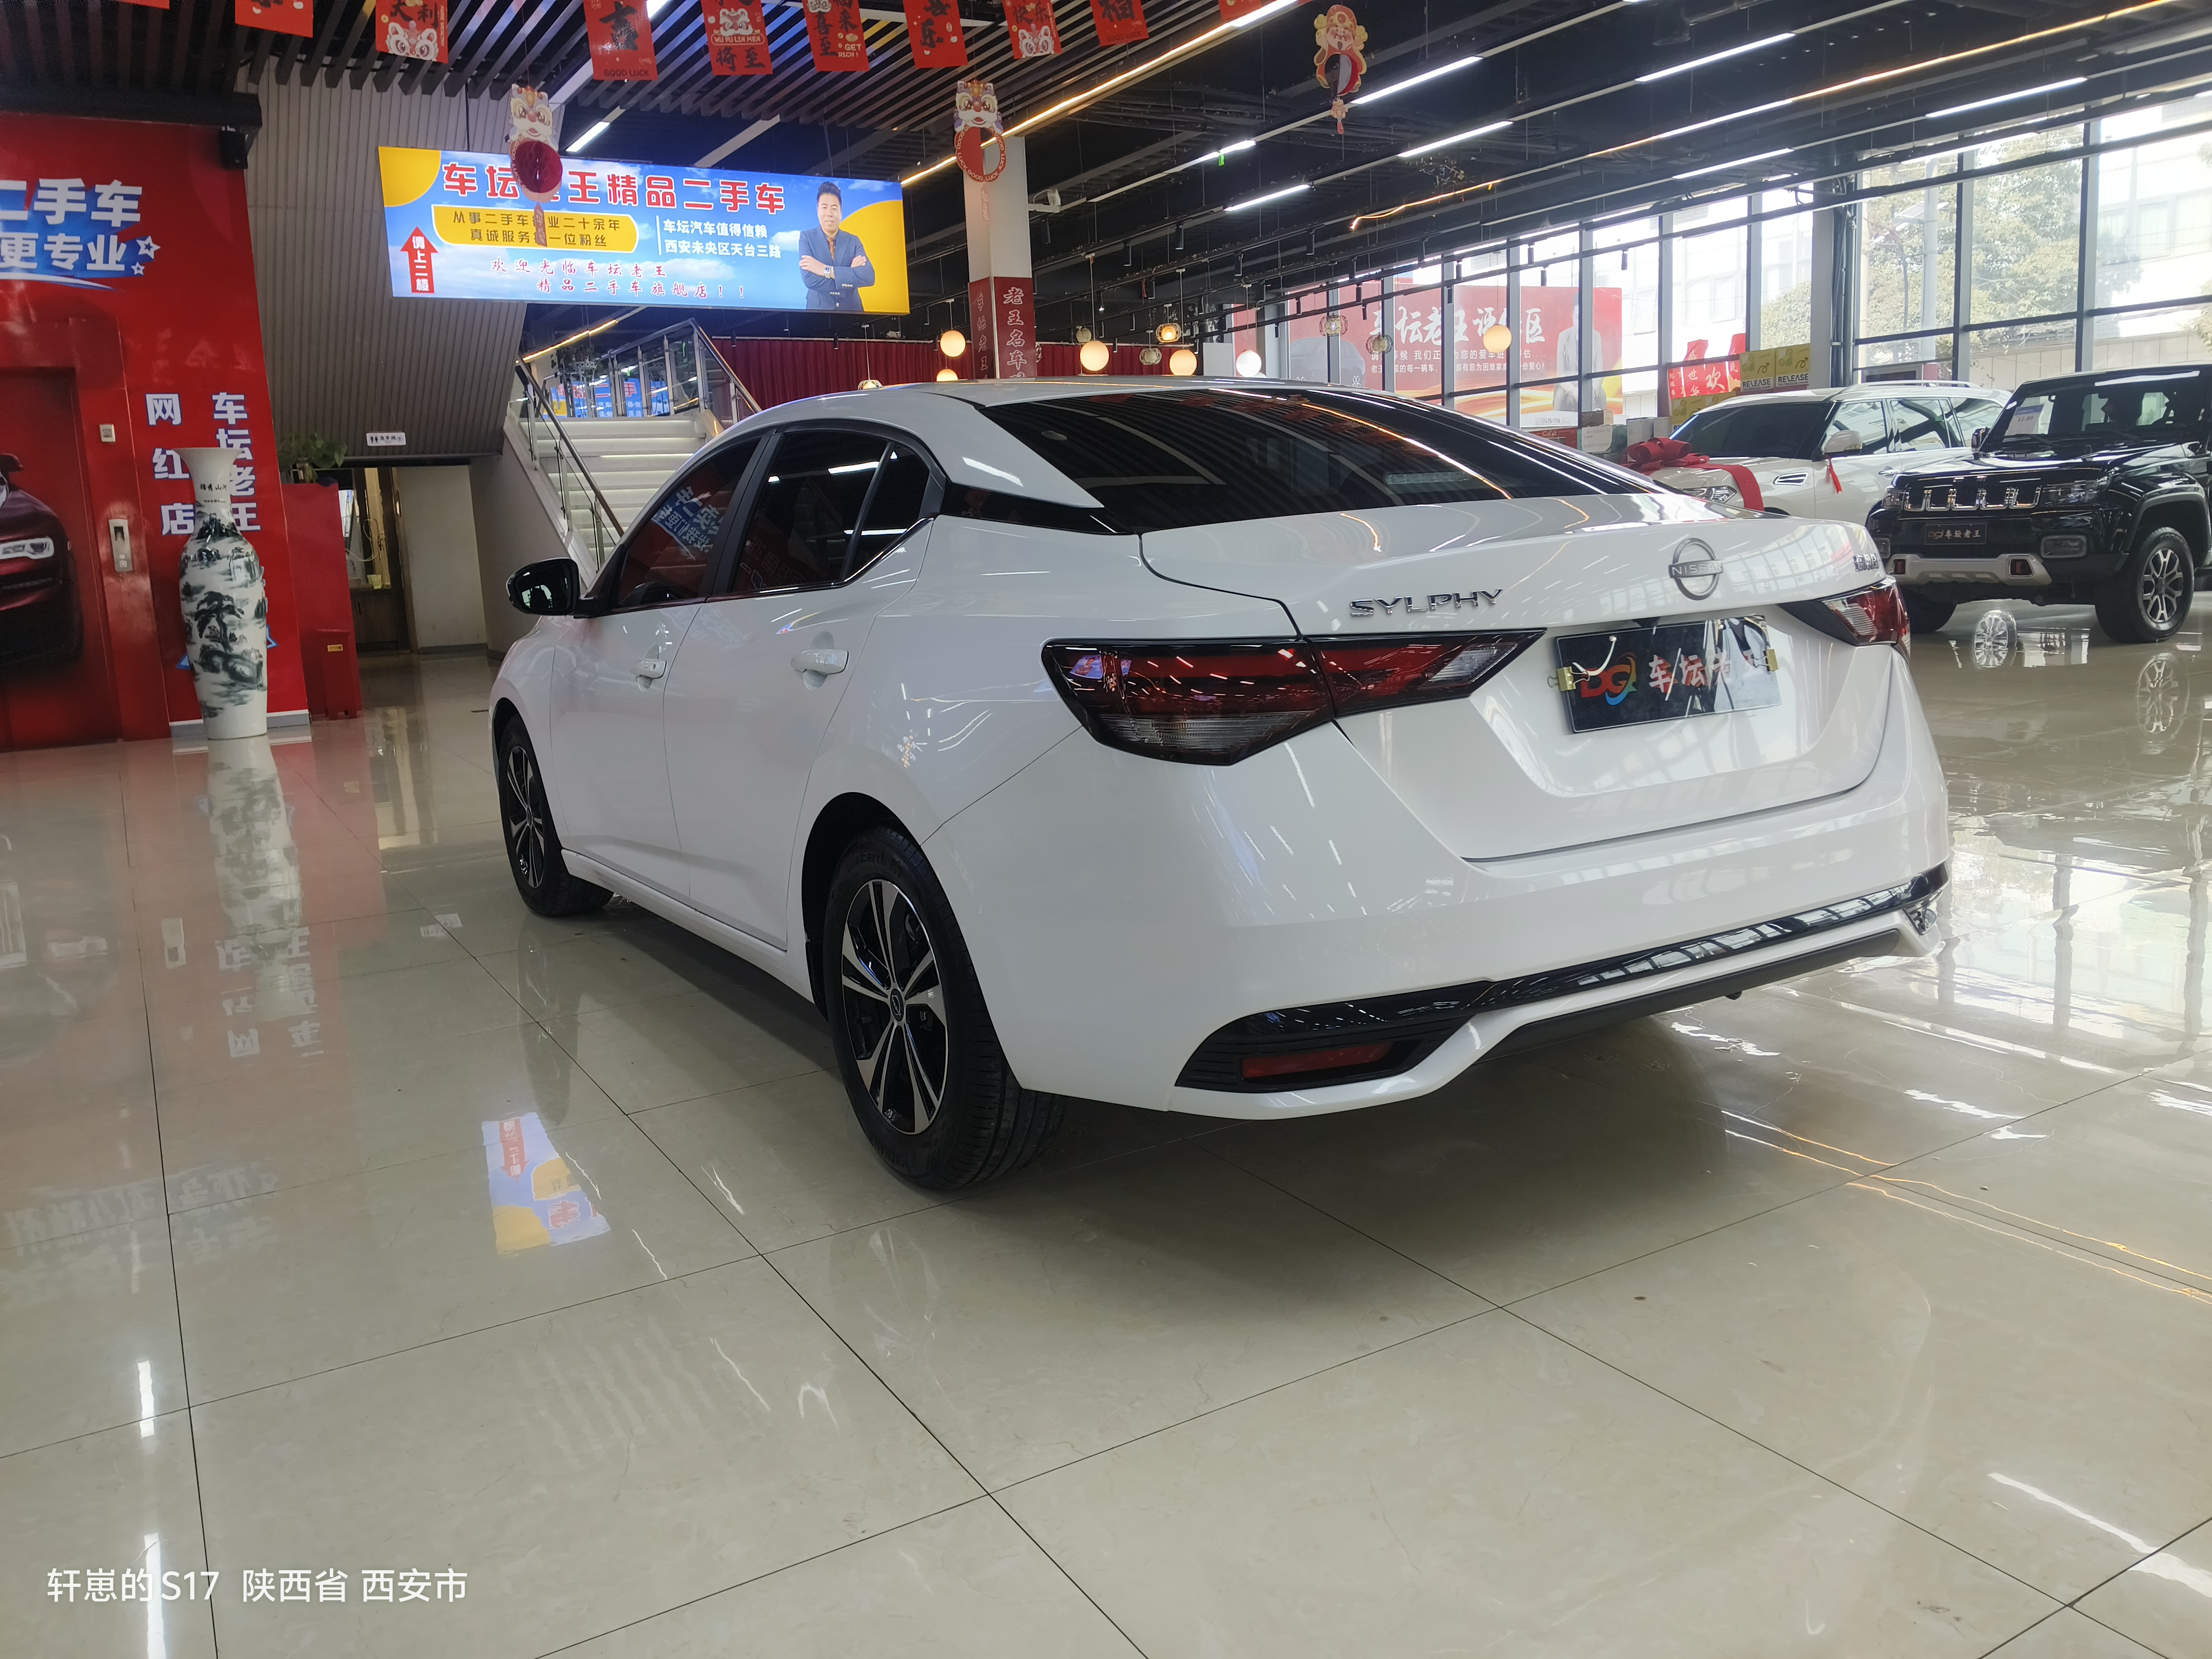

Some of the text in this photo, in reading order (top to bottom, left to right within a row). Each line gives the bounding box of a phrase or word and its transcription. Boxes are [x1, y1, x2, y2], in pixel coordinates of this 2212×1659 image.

[1106, 34, 1124, 42] GOOD
[968, 169, 998, 181] GOOD LUCK
[443, 162, 785, 215] 车坛王精品二手车
[453, 211, 620, 231] 从事二手车业二十余年
[663, 219, 767, 239] 车坛汽车值得信赖
[470, 228, 607, 247] 真诚服务一位粉丝
[0, 232, 127, 272] 更专业
[664, 239, 782, 258] 西安未央区天台三路
[412, 235, 429, 292] 请上二楼
[977, 292, 988, 378] 车坛老王
[1743, 378, 1770, 388] RELEASE
[1778, 373, 1809, 383] RELEASE
[1672, 562, 1723, 575] NISSAN
[1350, 588, 1504, 617] SYLPHY
